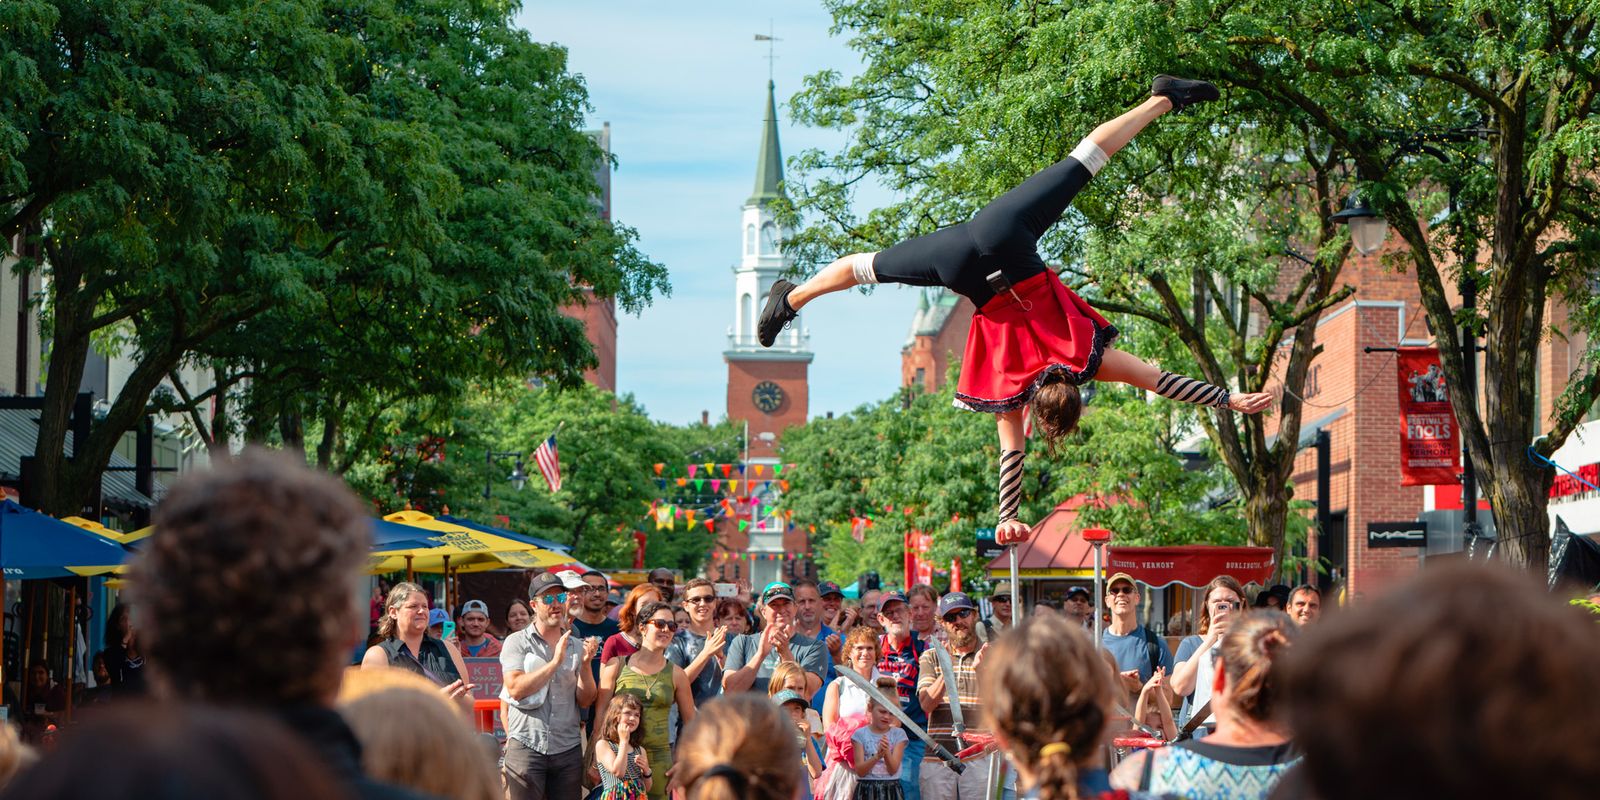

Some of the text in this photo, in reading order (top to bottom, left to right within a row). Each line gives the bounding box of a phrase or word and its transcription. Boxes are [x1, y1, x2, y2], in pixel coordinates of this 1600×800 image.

[1407, 424, 1451, 439] FOOLS
[1370, 530, 1424, 539] MAC
[472, 683, 502, 696] PIZ
